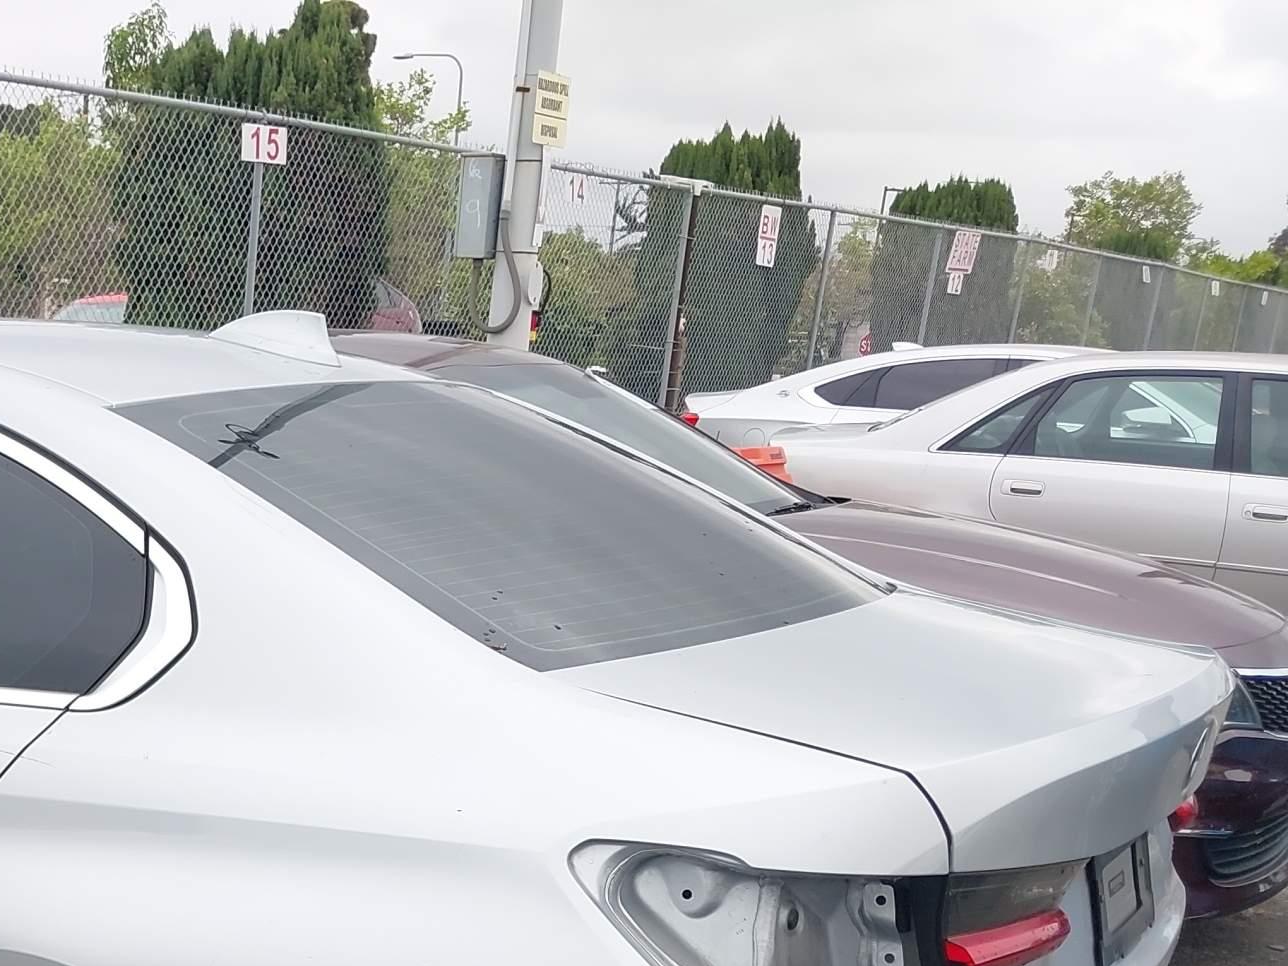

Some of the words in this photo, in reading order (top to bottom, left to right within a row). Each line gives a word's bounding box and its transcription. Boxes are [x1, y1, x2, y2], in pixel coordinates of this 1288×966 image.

[251, 127, 279, 160] 15
[569, 176, 584, 204] 14
[761, 214, 778, 237] BW
[955, 231, 980, 250] STATE
[762, 241, 773, 265] 13
[951, 248, 976, 267] FARM
[951, 274, 961, 293] 12
[860, 340, 872, 353] ST
